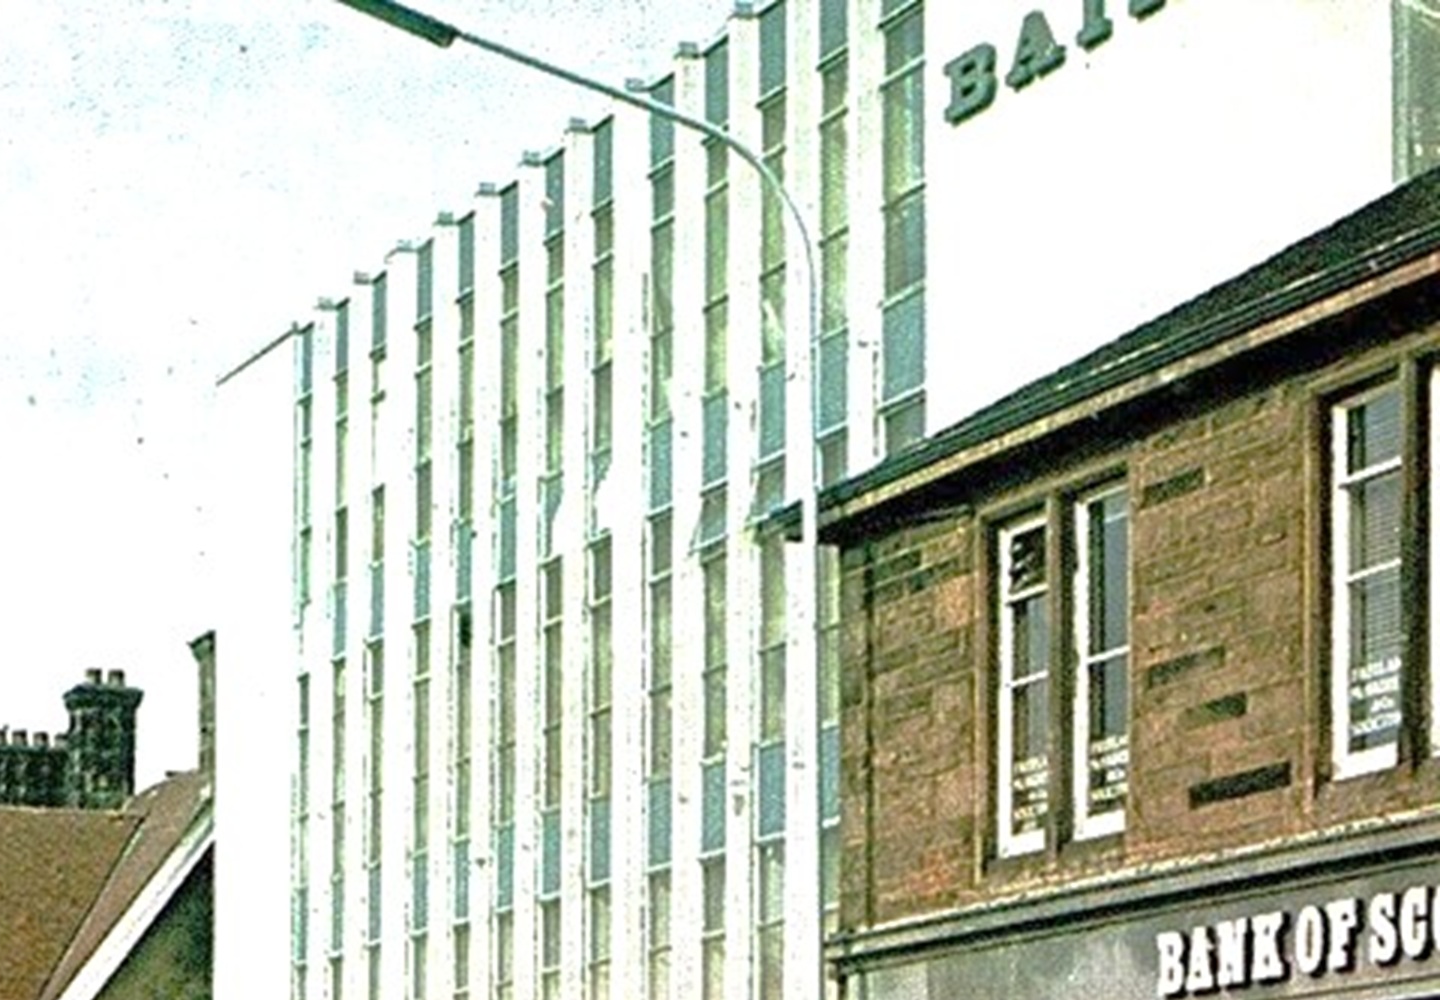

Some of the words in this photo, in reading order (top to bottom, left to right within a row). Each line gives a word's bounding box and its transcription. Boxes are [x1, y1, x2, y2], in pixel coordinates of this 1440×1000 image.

[943, 0, 1167, 128] BAI
[1157, 911, 1286, 999] BANK
[1295, 897, 1360, 977] OF
[1370, 885, 1440, 967] SC
